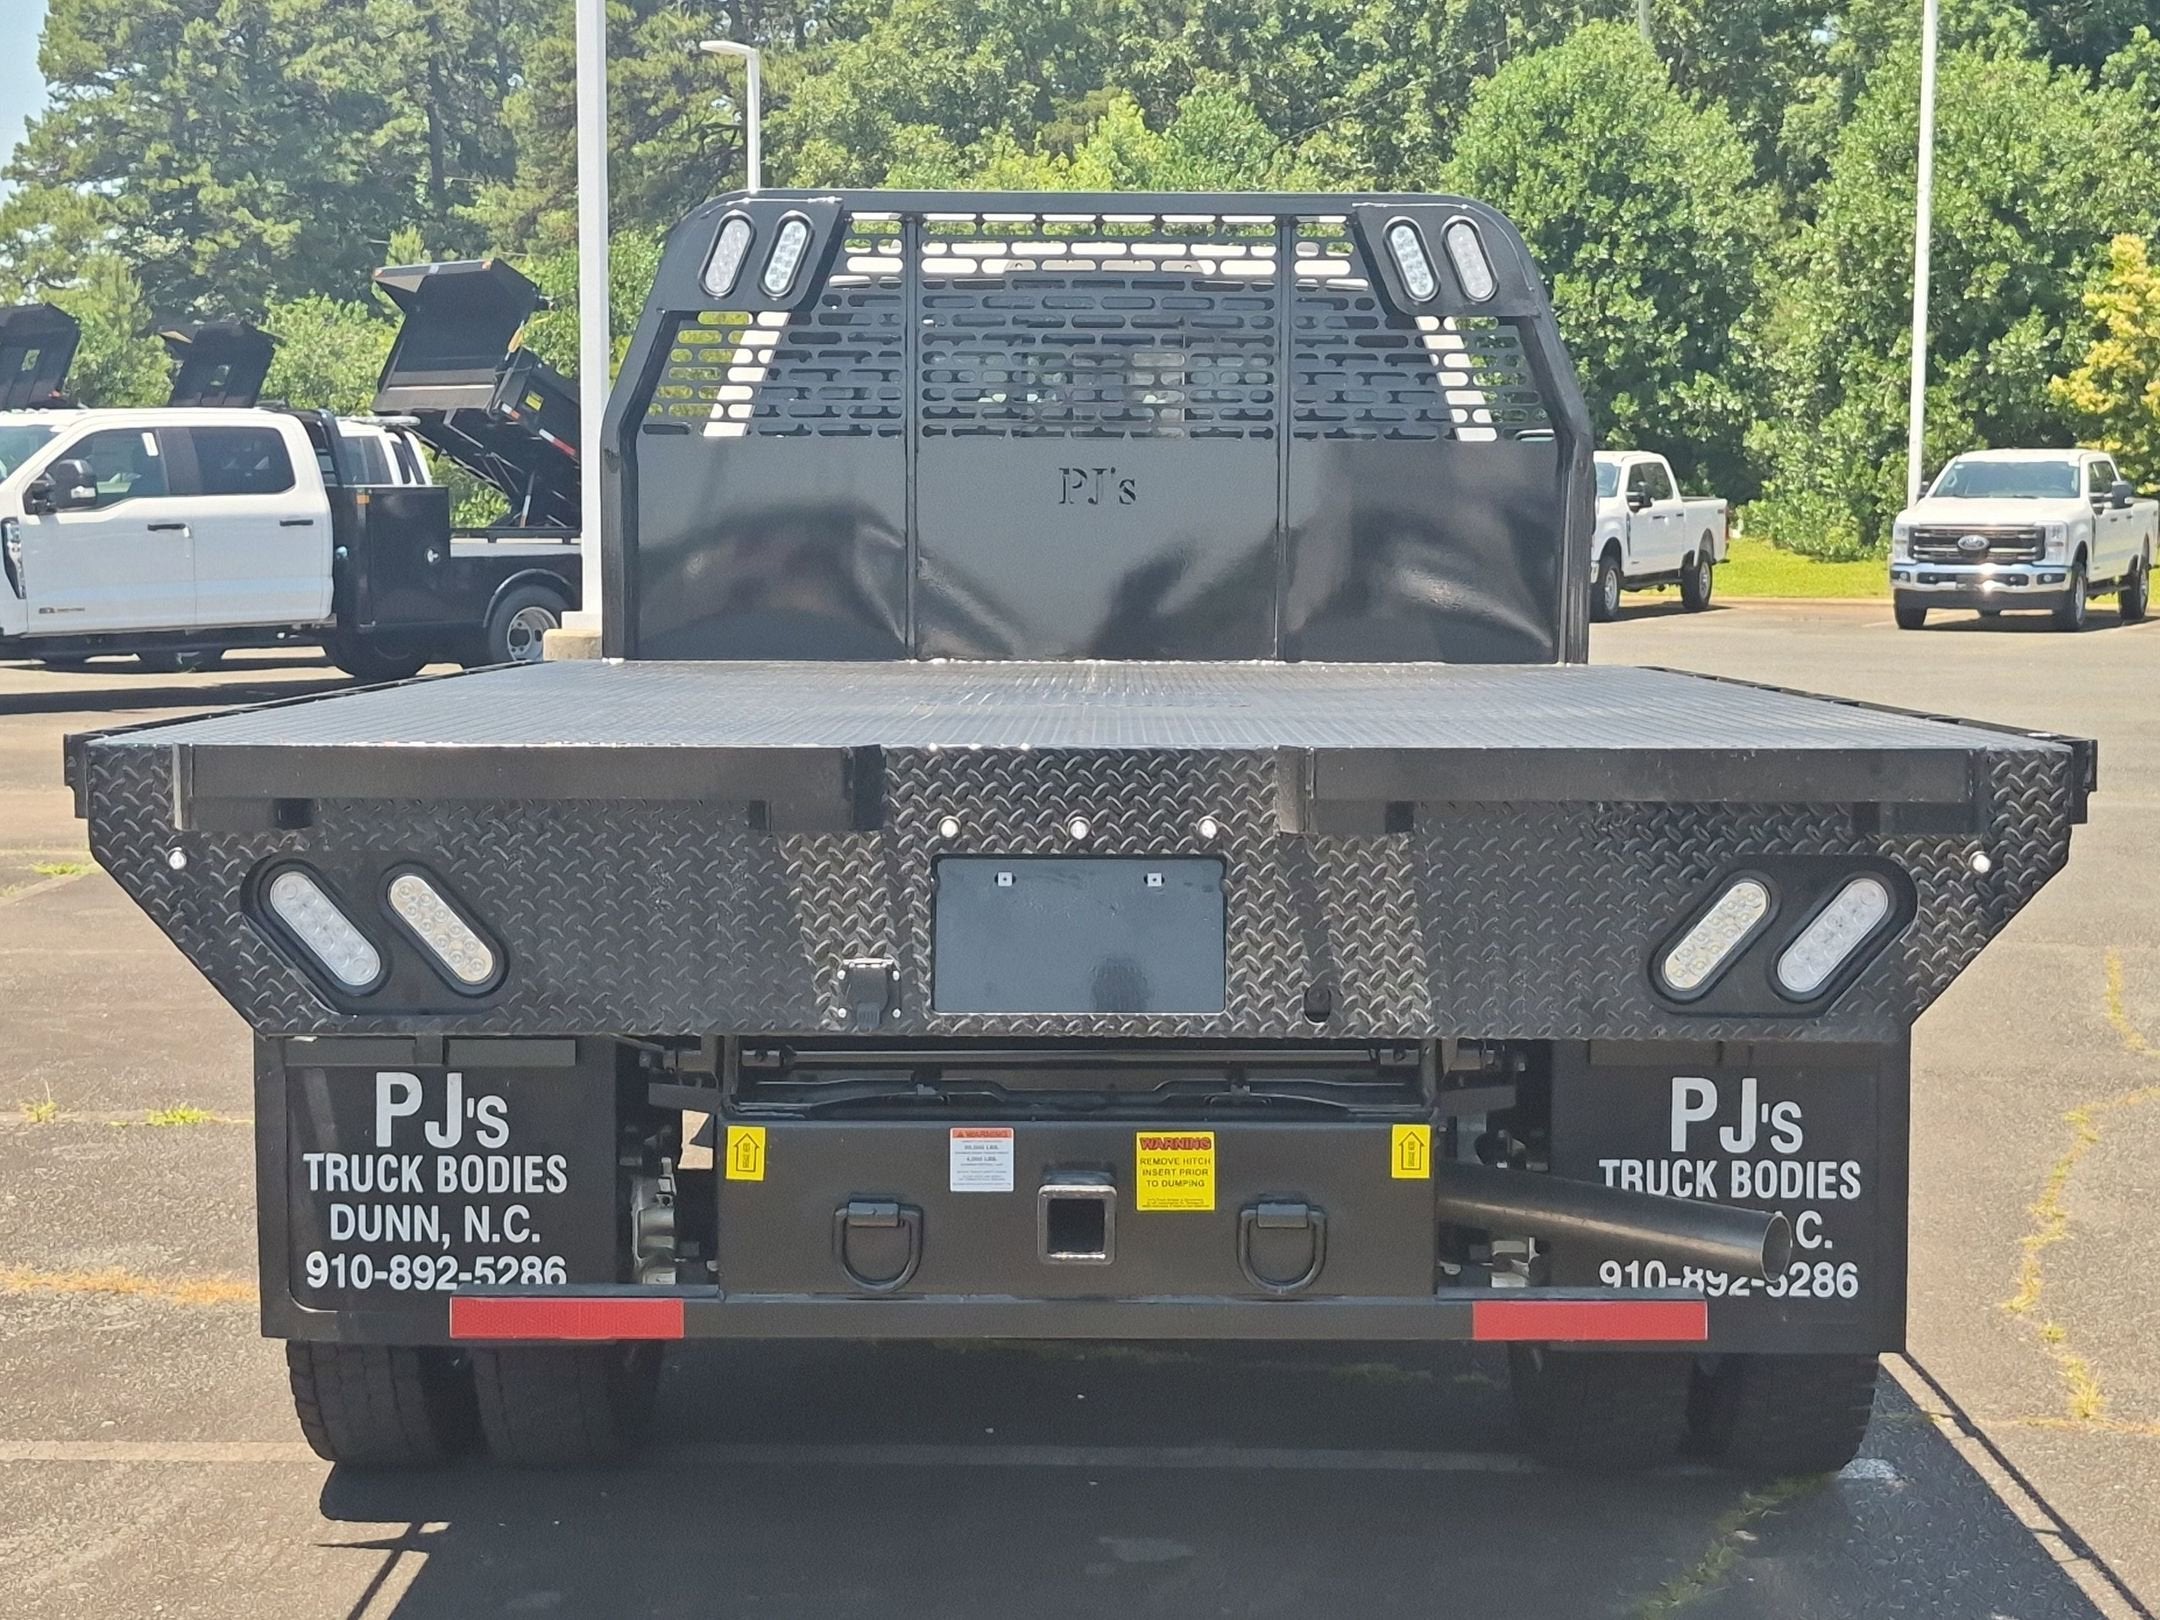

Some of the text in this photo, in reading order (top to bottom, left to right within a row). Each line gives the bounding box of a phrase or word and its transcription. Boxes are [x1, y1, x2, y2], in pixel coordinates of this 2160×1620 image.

[1058, 466, 1137, 505] PJ's
[375, 1071, 510, 1149] PJ's
[1671, 1077, 1804, 1154] PJ's
[1139, 1136, 1212, 1151] WARNING
[1139, 1157, 1211, 1166] REMOVE HITCH
[302, 1152, 568, 1194] TRUCK BODIES
[1142, 1168, 1209, 1177] INSERT PRIOR
[1146, 1179, 1205, 1188] TO DUMPING
[1598, 1159, 1861, 1200] TRUCK BODIES
[330, 1203, 541, 1250] DUNN, N.C.
[305, 1250, 567, 1291] 910-892-5286
